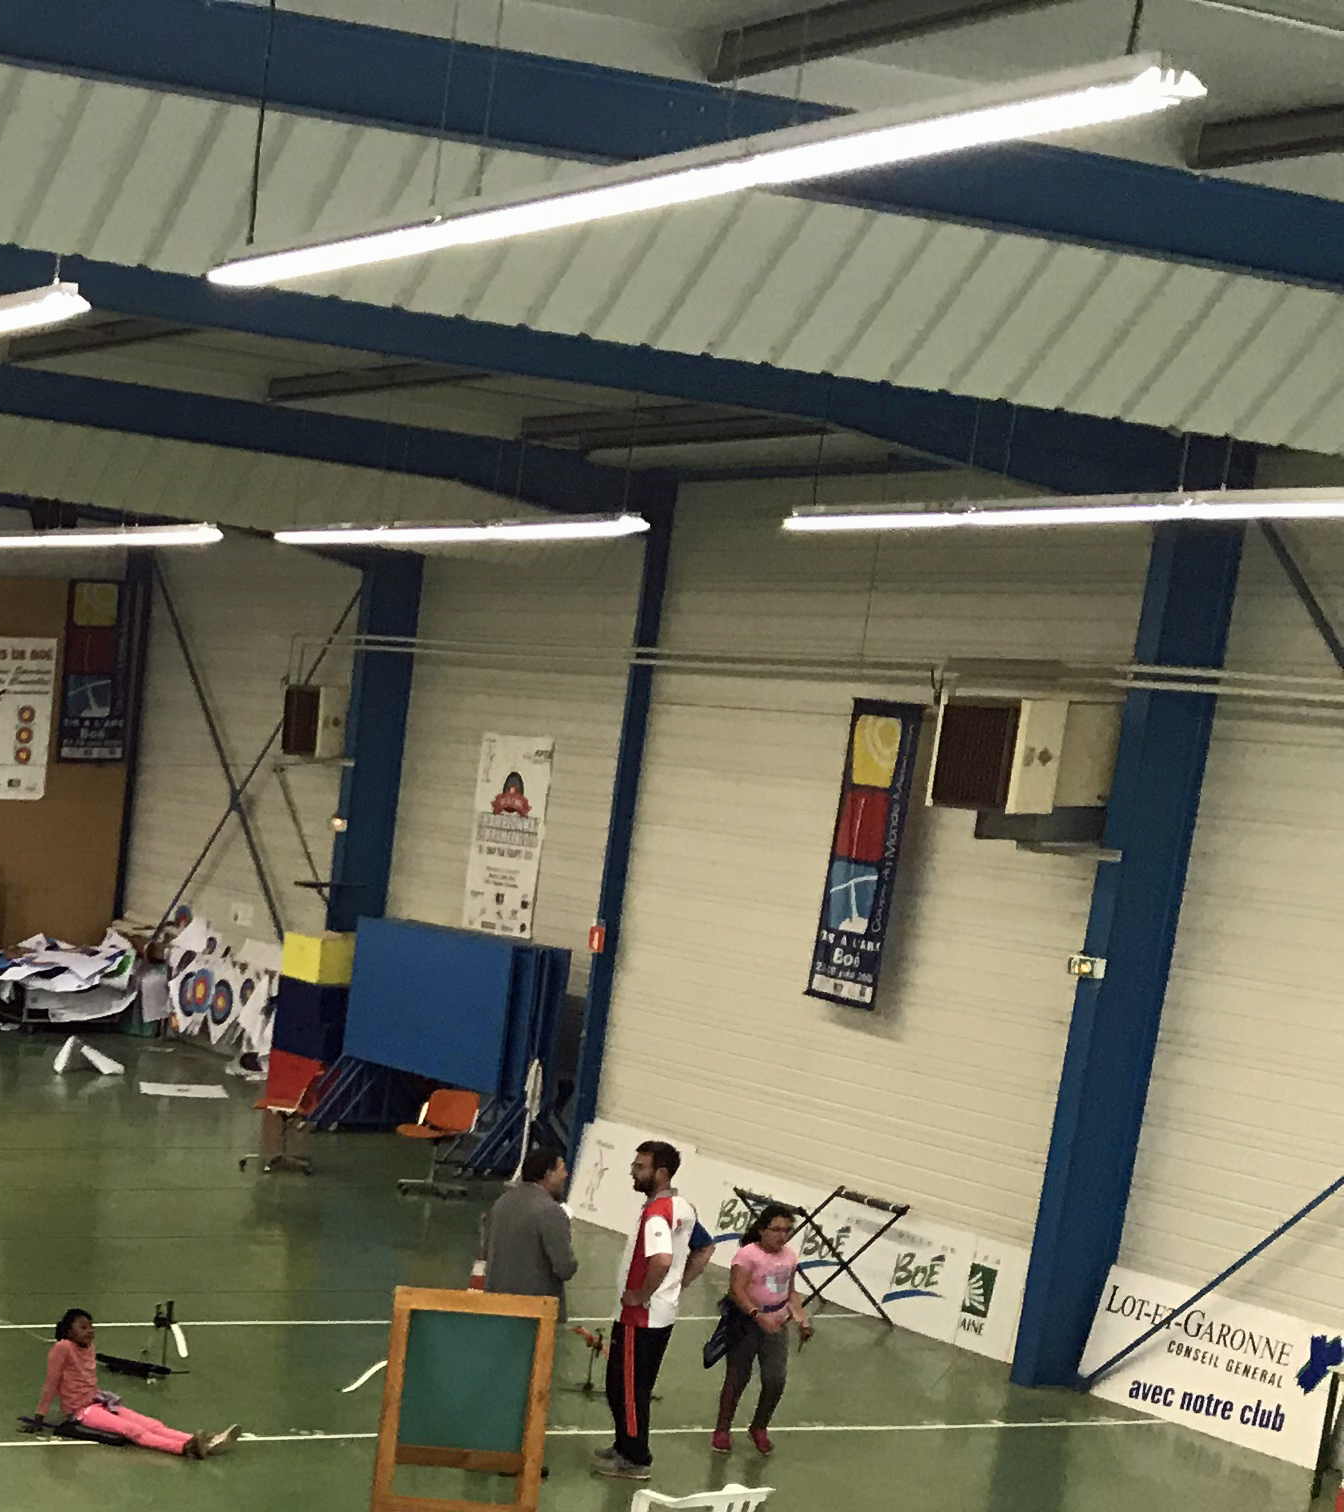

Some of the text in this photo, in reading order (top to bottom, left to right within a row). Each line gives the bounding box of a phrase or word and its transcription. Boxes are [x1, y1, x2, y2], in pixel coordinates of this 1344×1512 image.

[1166, 1340, 1284, 1389] CONSEIL GENERAL
[1128, 1379, 1286, 1433] avec notre club
